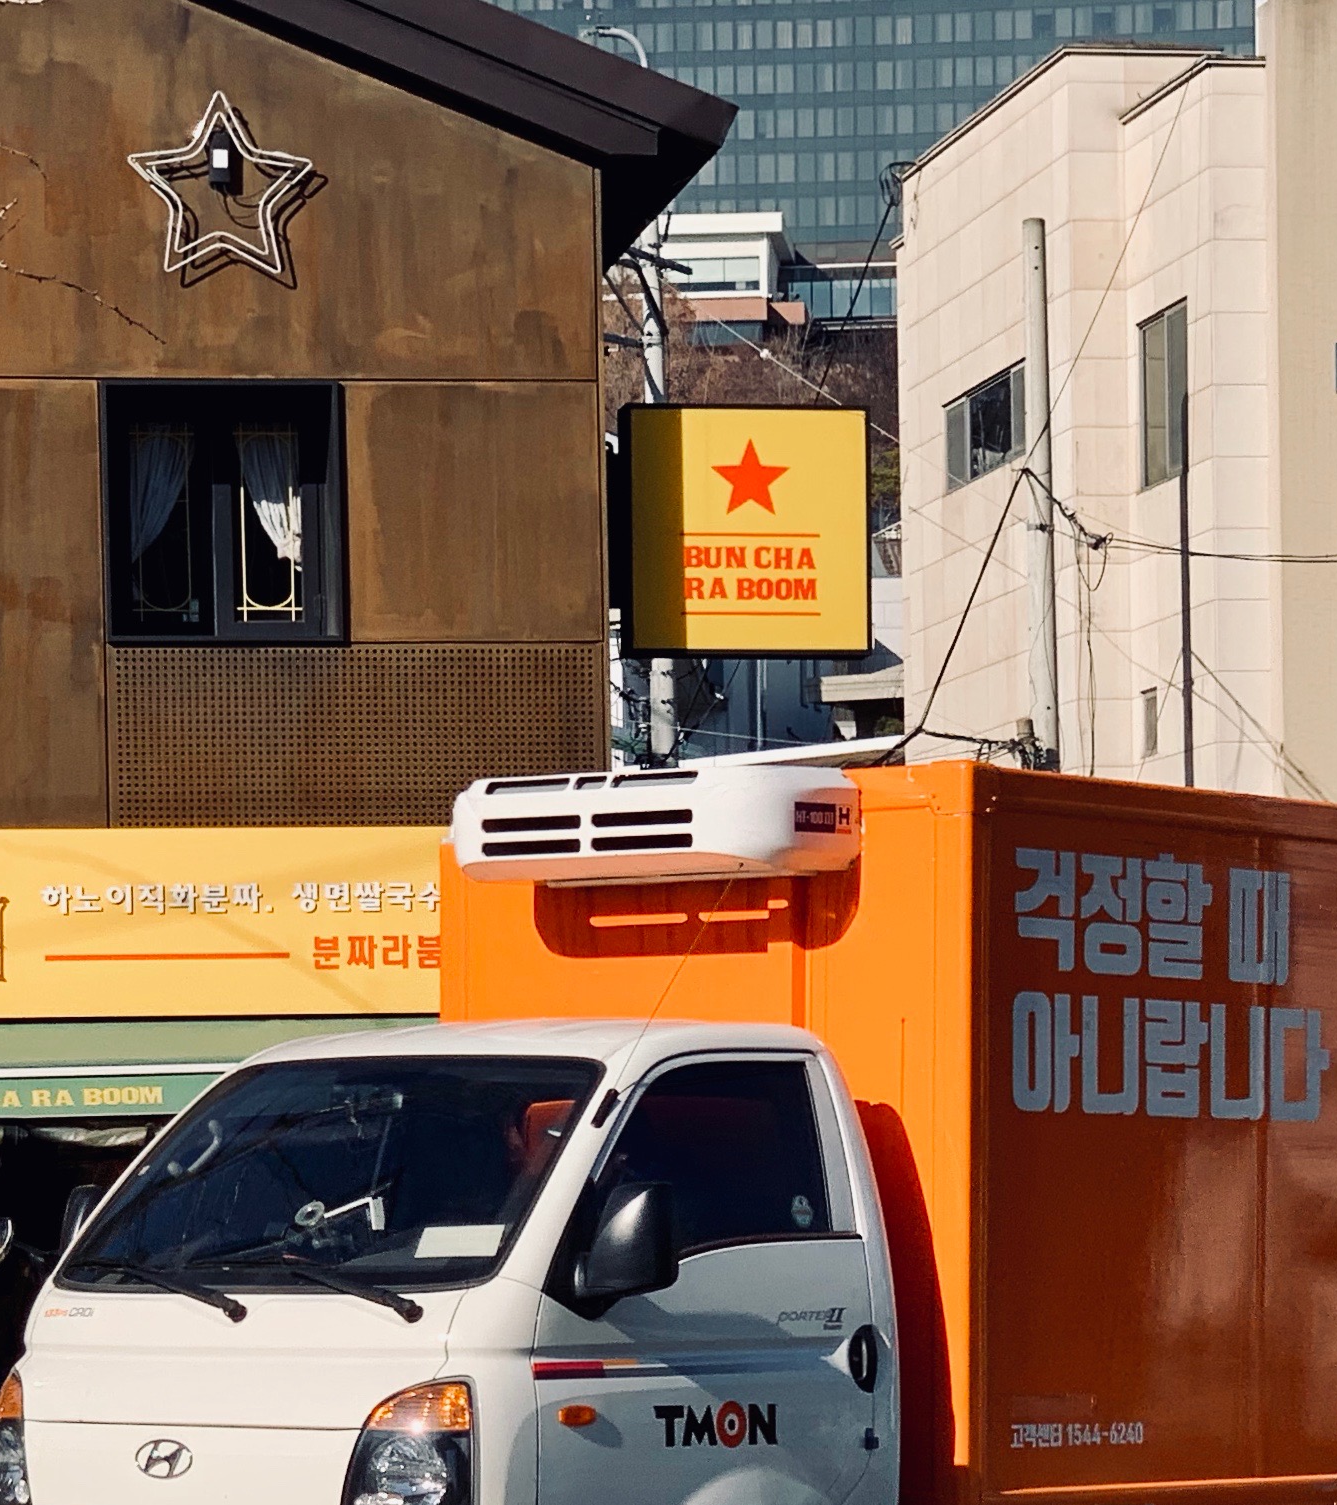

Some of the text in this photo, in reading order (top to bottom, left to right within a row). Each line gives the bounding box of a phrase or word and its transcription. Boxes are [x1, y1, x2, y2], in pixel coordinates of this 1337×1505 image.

[684, 545, 817, 570] BUN CHA
[684, 577, 818, 601] RA BOOM
[291, 880, 440, 913] 생면쌀국수
[1015, 847, 1290, 985] 걱정할 때
[312, 934, 441, 970] 분짜라붐
[1012, 991, 1331, 1122] 아니랍니다
[31, 1088, 74, 1107] RA
[83, 1086, 164, 1106] BOOM
[653, 1400, 778, 1448] TMON
[1066, 1421, 1144, 1446] 1544-6240
